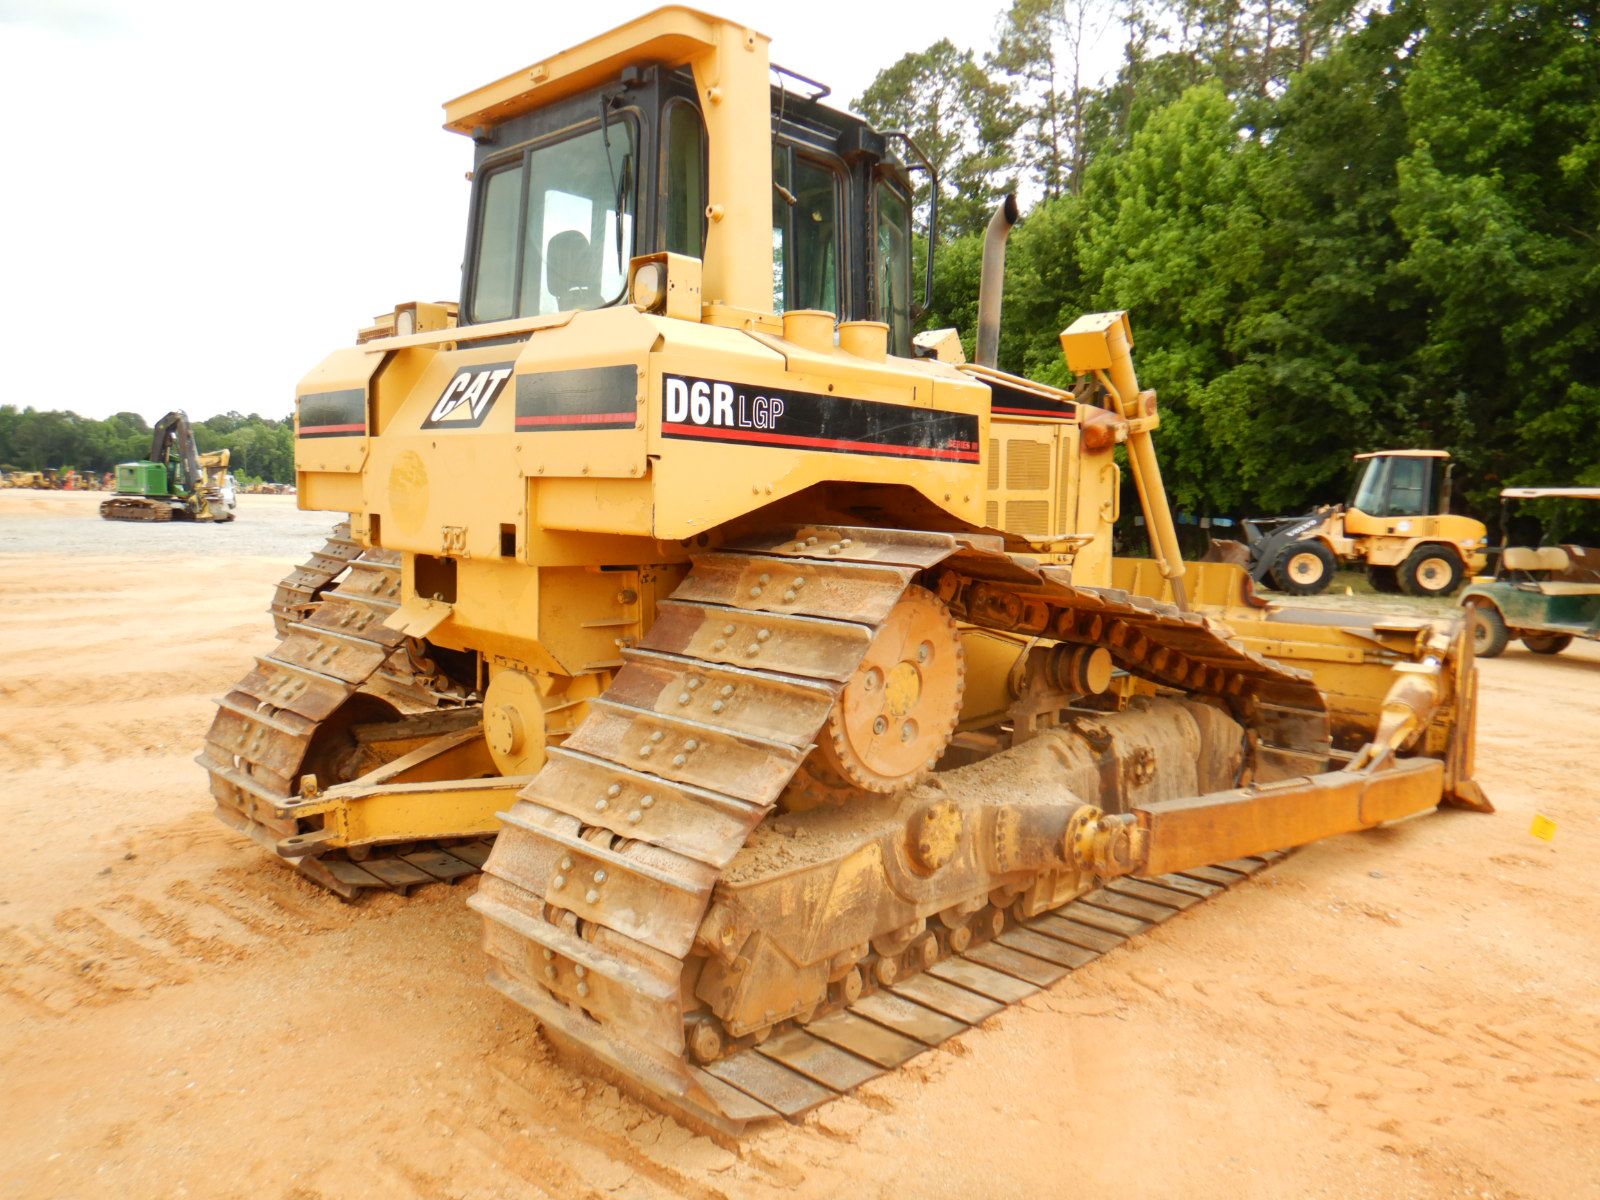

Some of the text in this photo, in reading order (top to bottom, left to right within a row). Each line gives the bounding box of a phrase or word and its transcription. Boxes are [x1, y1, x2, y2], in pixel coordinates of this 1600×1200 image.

[431, 368, 514, 422] CAT
[666, 378, 784, 429] D6R LGP
[1285, 519, 1318, 537] VOLVO
